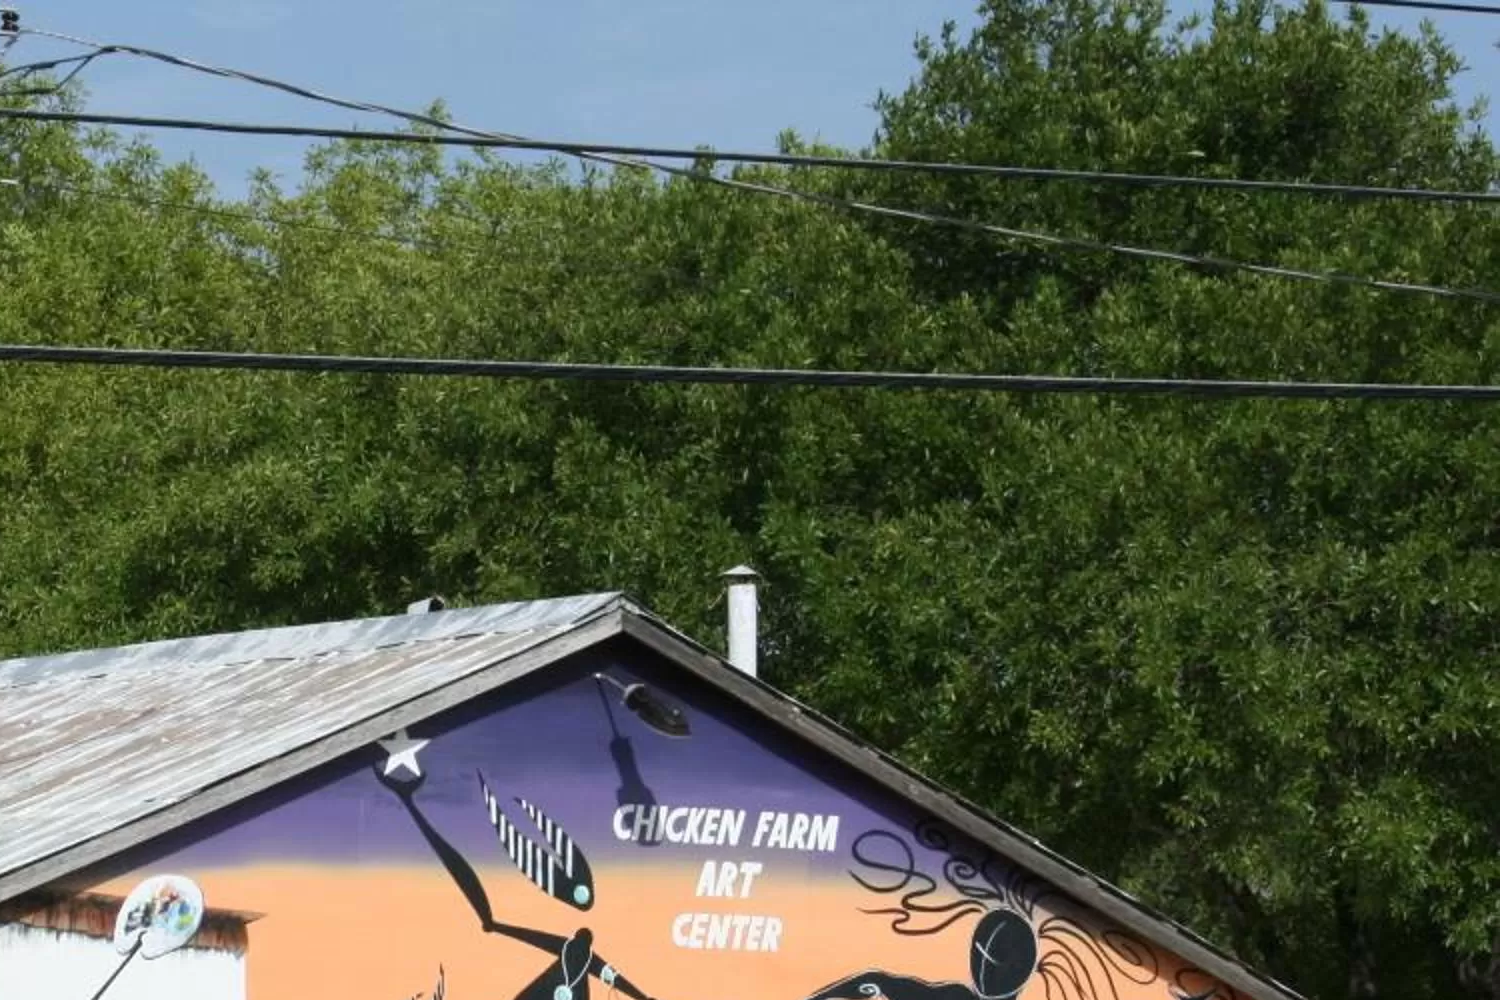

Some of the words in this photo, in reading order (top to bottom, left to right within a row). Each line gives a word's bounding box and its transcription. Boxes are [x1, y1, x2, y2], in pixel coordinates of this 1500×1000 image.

[613, 804, 746, 846] CHICKEN
[752, 811, 839, 851] FARM
[696, 861, 763, 898] ART
[672, 913, 783, 952] CENTER
